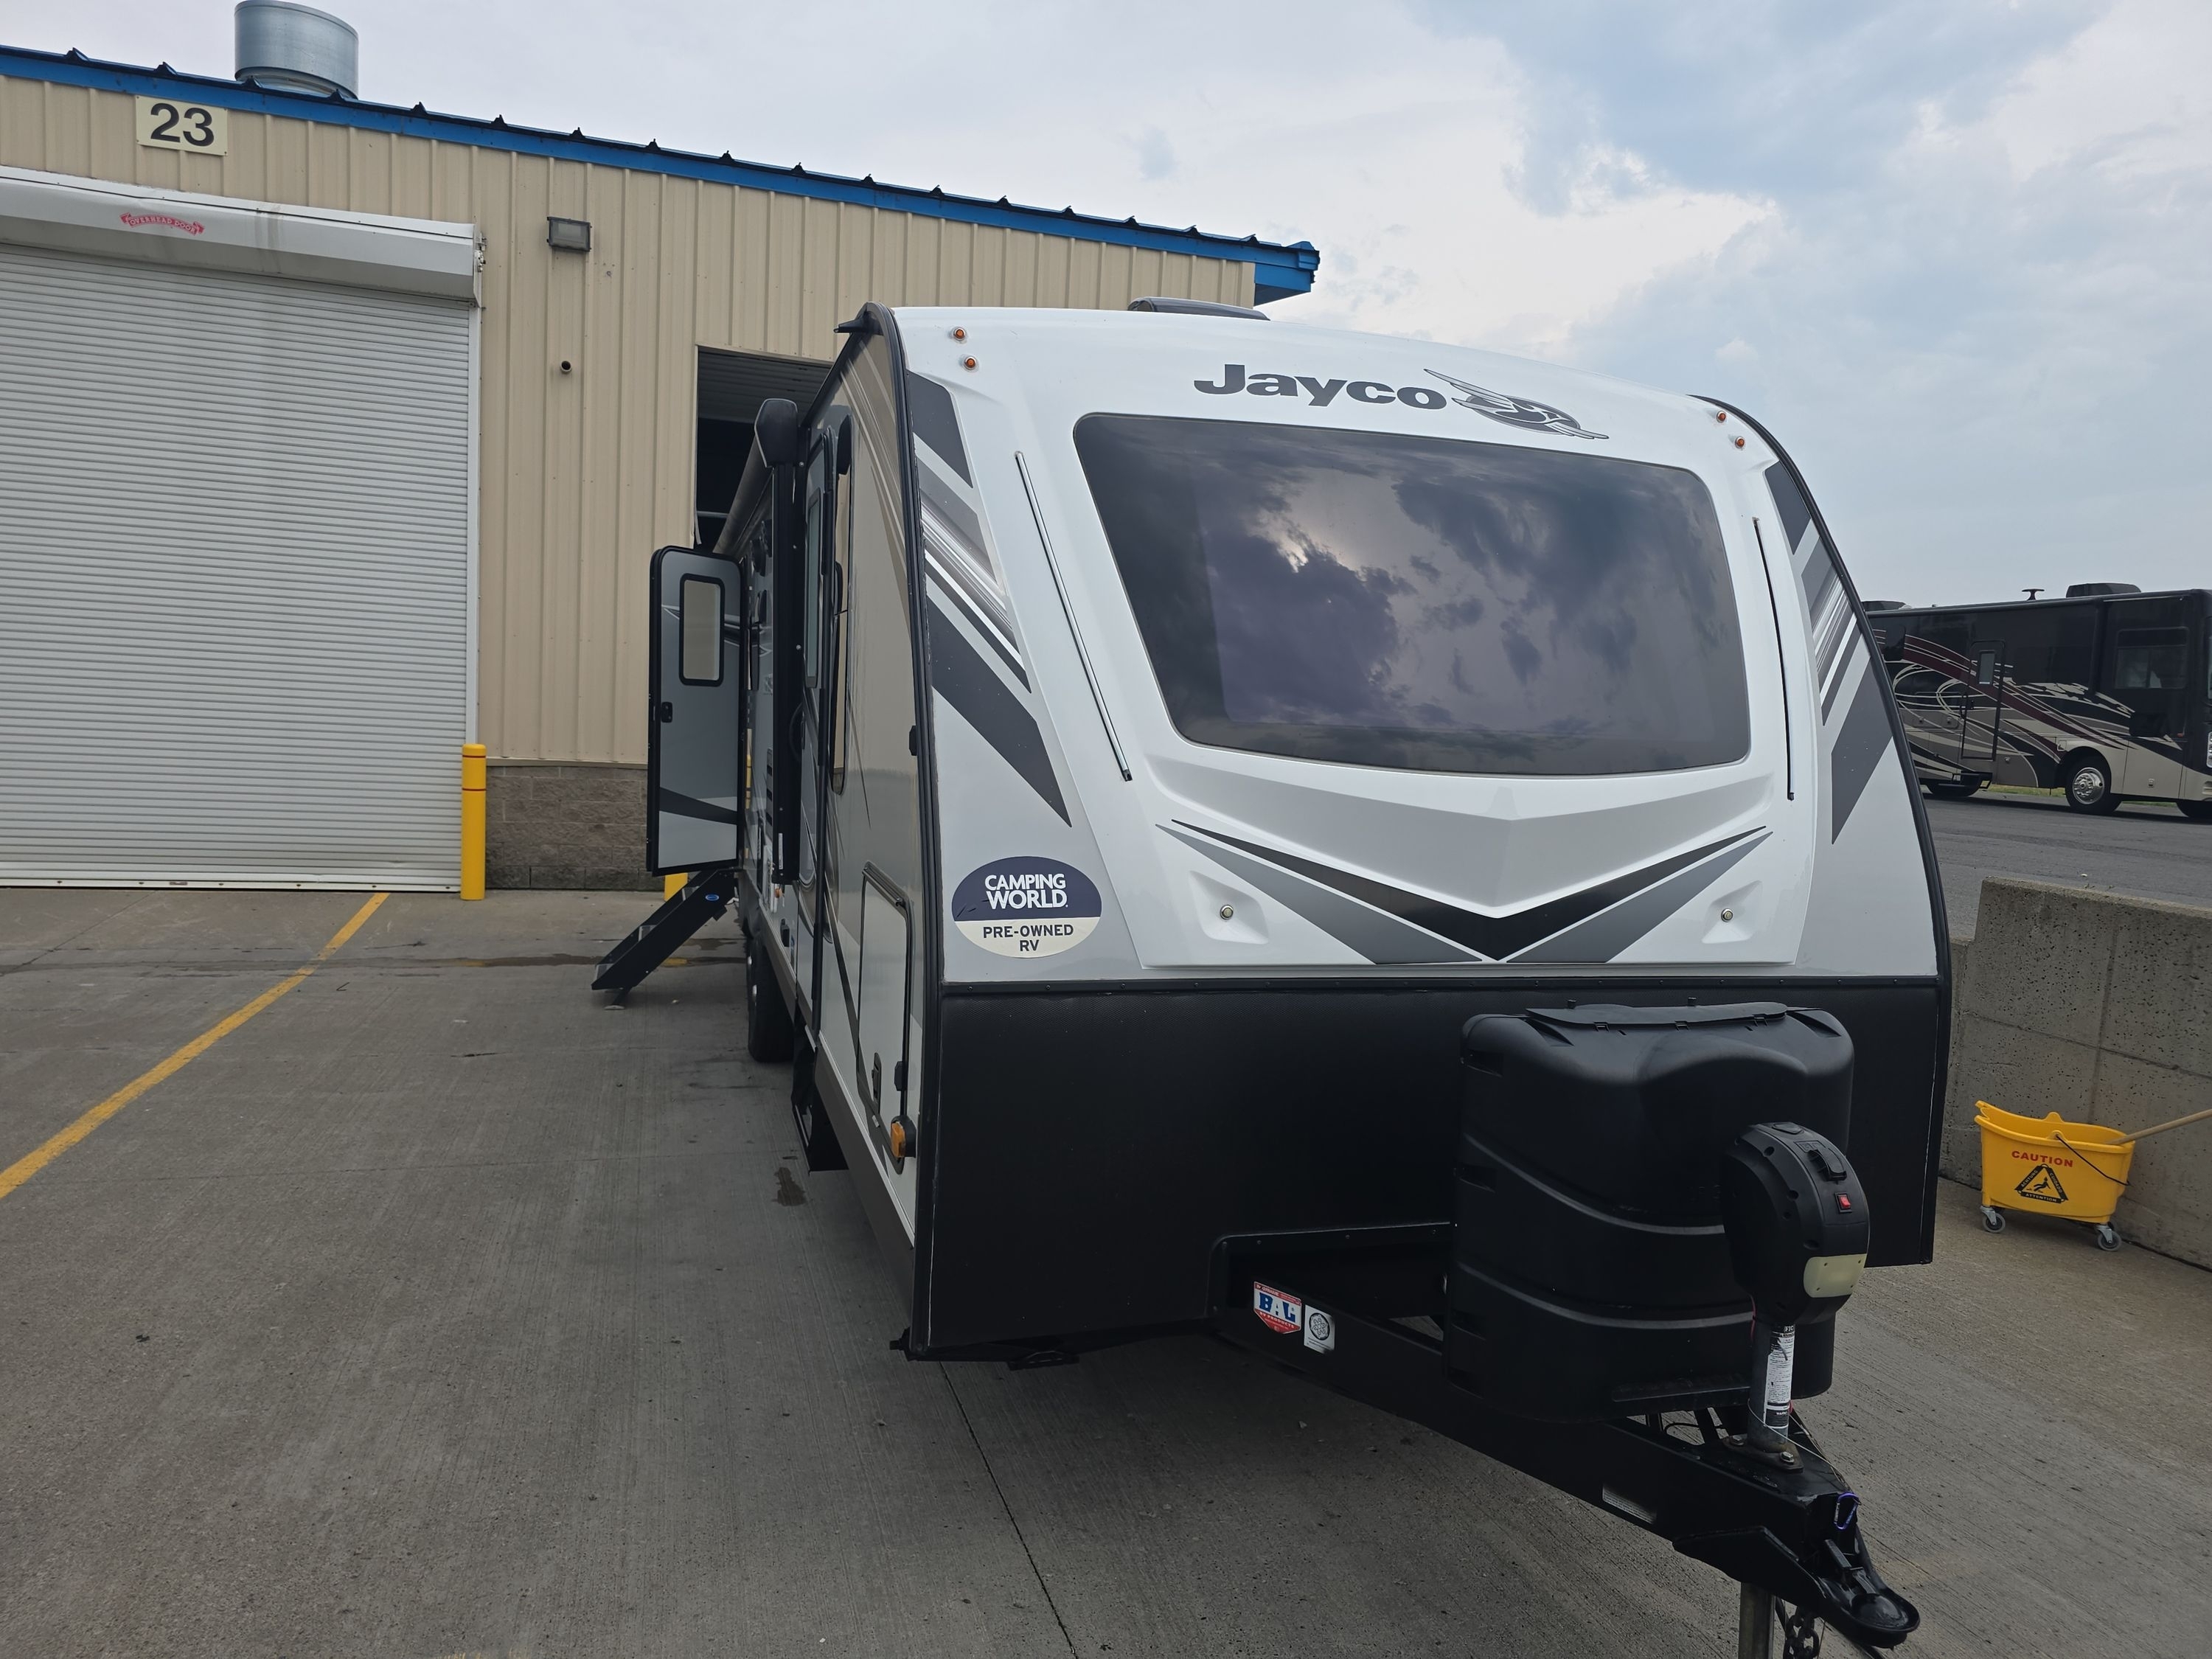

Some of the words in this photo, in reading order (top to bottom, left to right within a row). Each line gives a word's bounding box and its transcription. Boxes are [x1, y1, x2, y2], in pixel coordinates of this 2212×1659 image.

[150, 102, 215, 147] 23
[130, 217, 173, 226] OVERHEAD
[175, 220, 196, 234] DOOR
[1194, 364, 1447, 410] Jayco
[984, 873, 1066, 891] CAMPING
[983, 924, 1074, 939] PRE-OWNED
[1020, 939, 1040, 952] RV
[2011, 1150, 2073, 1167] CAUTION
[2021, 1170, 2038, 1187] ACHTUNG
[2050, 1172, 2063, 1193] CUIDADO
[2025, 1193, 2057, 1203] ATTENTION
[1259, 1292, 1296, 1324] BAL
